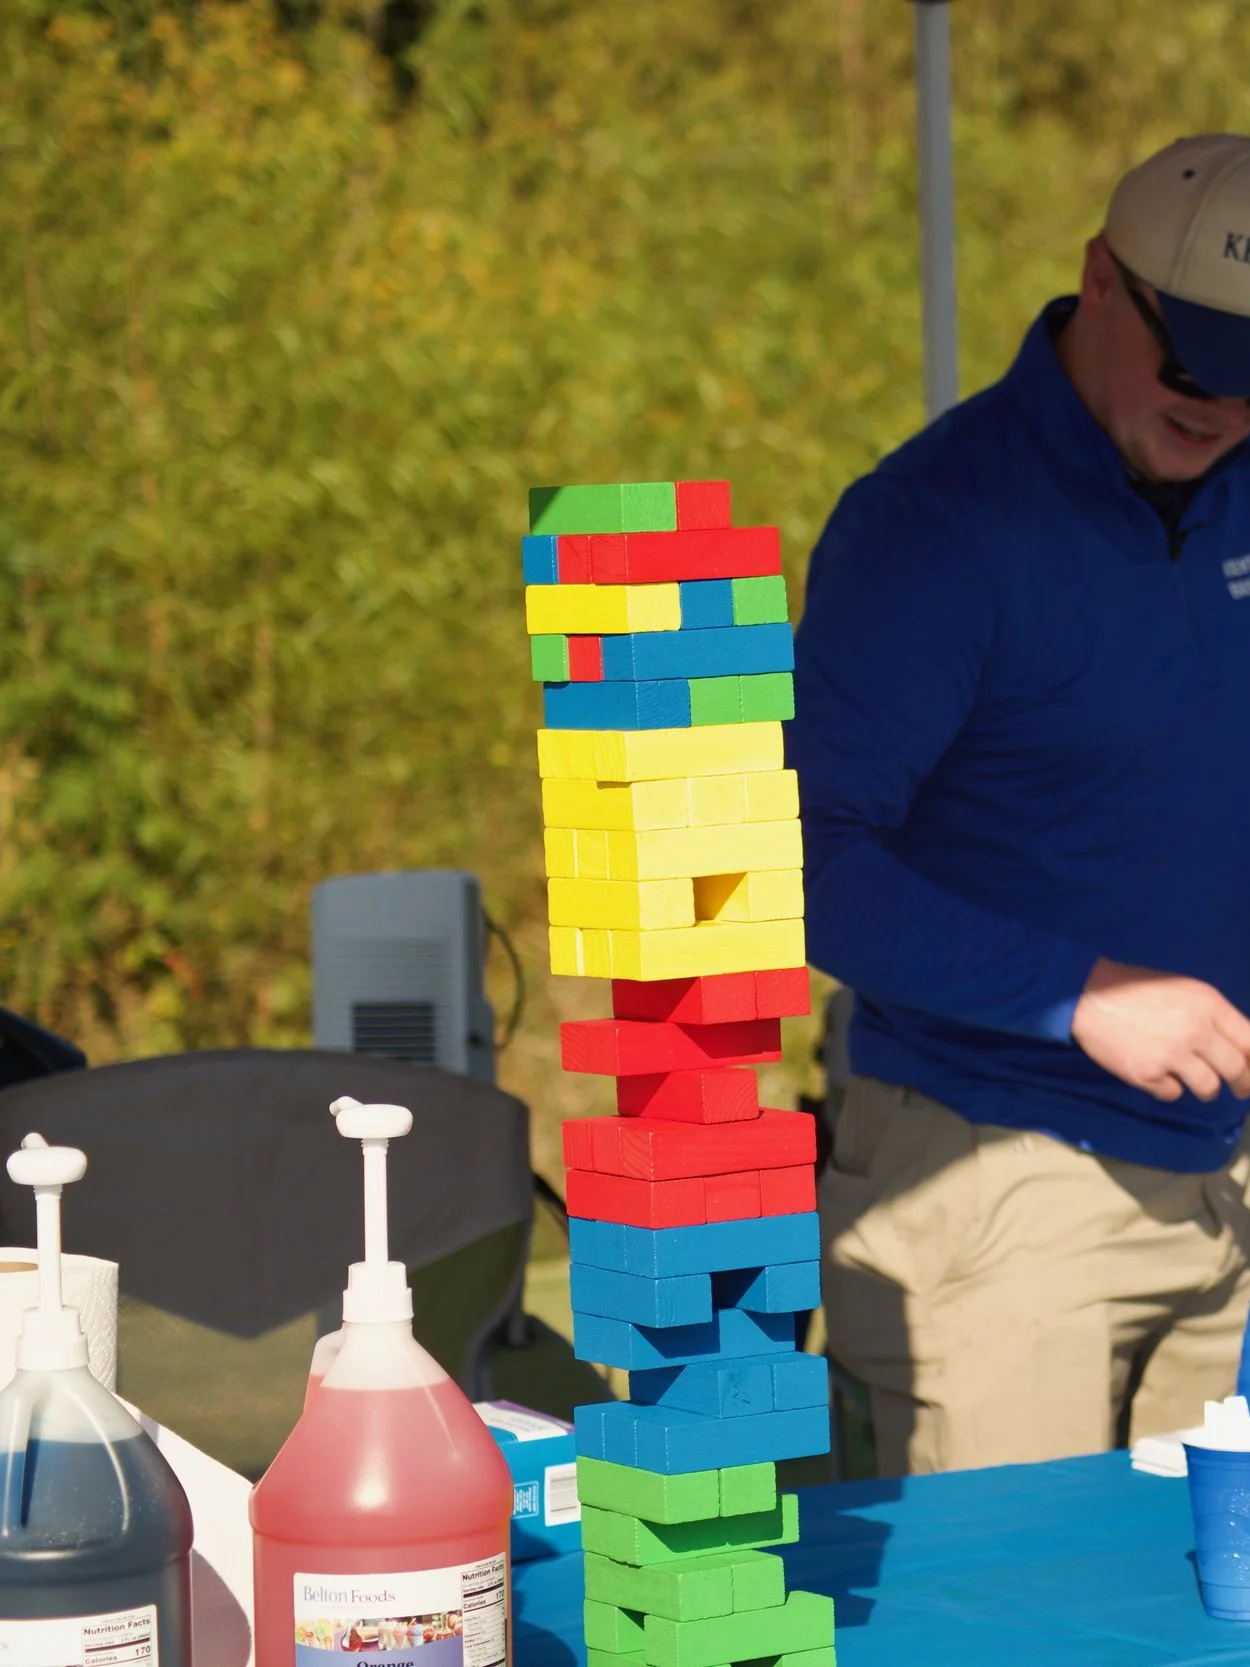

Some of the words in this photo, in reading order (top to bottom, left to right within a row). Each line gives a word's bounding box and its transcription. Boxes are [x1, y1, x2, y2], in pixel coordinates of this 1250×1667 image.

[463, 1569, 491, 1581] Nutrition
[491, 1563, 504, 1574] Facts
[303, 1585, 348, 1604] Belton
[351, 1588, 396, 1604] Foods
[463, 1600, 486, 1610] Calories
[84, 1624, 125, 1636] Nutrition
[127, 1618, 150, 1629] Facts
[85, 1655, 118, 1666] Calories
[135, 1645, 151, 1656] 170
